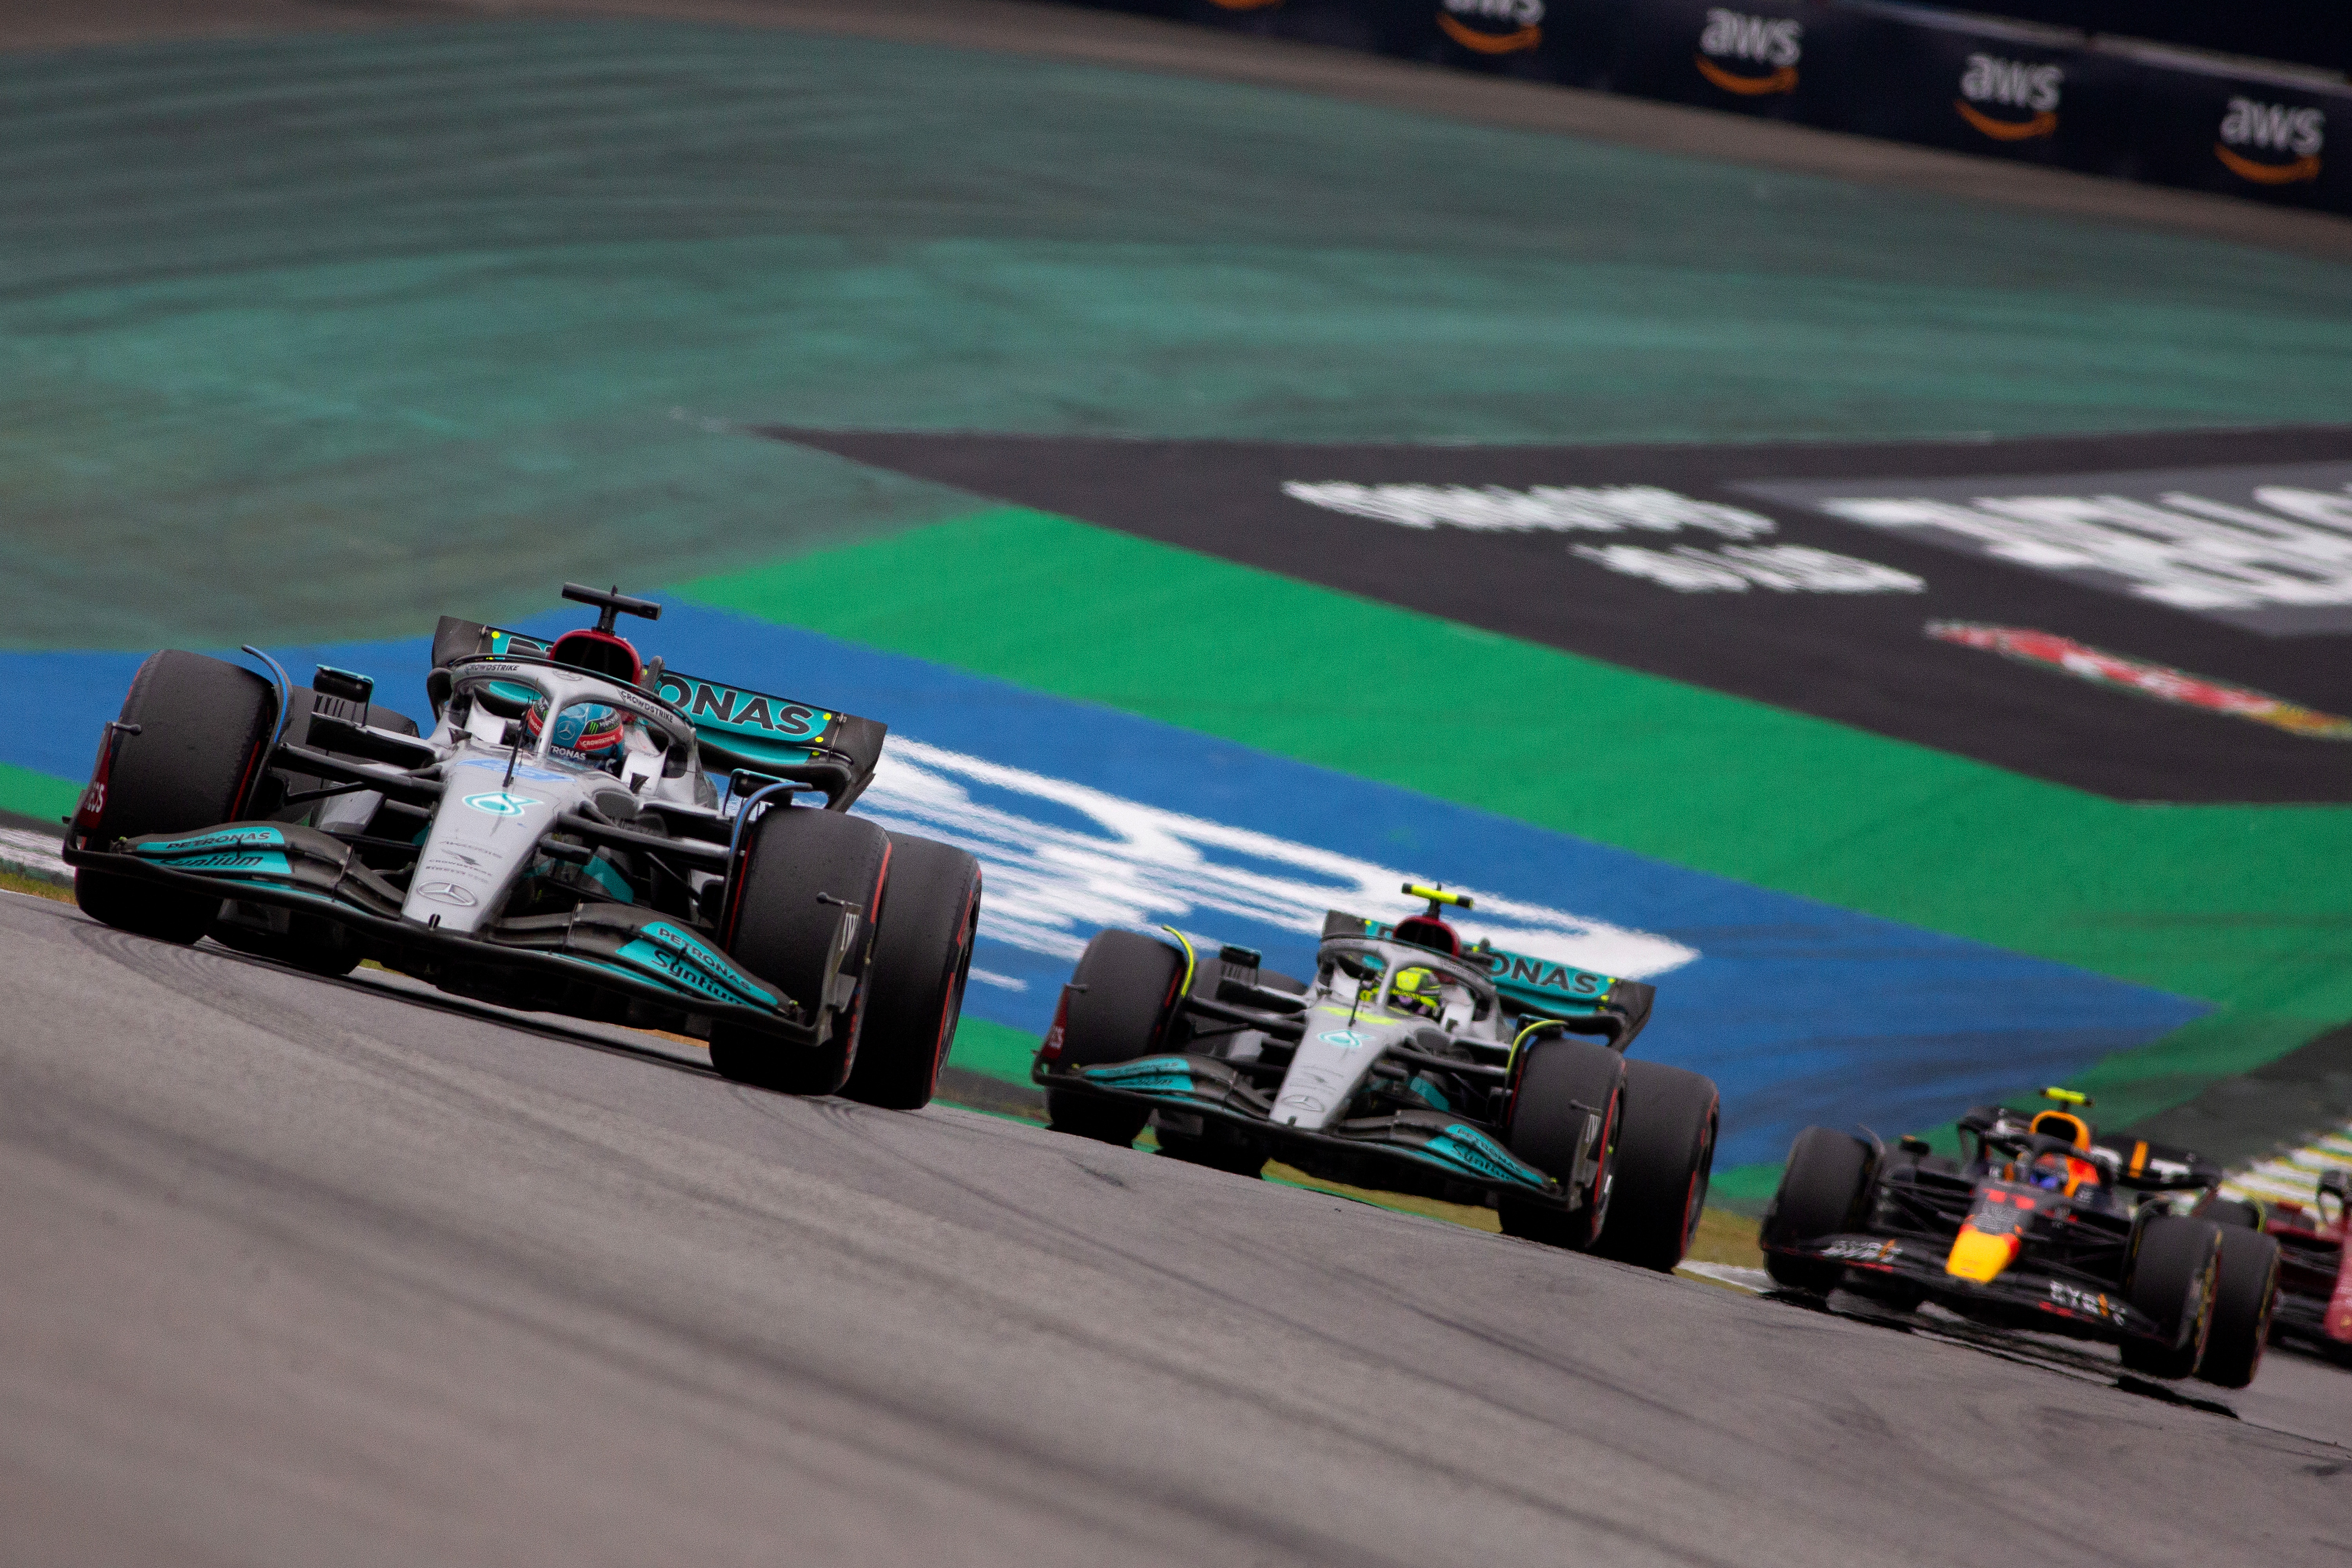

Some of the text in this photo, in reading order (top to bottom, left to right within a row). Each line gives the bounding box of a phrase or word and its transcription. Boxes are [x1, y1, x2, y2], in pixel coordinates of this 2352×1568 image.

[1701, 7, 1801, 66] aws
[1962, 53, 2063, 111] aws
[2220, 96, 2324, 155] aws
[620, 690, 673, 723] CROWDSTRIKE
[166, 832, 270, 849] PETRONAS
[651, 949, 743, 1005] Syntium
[659, 927, 751, 990] PETRONAS
